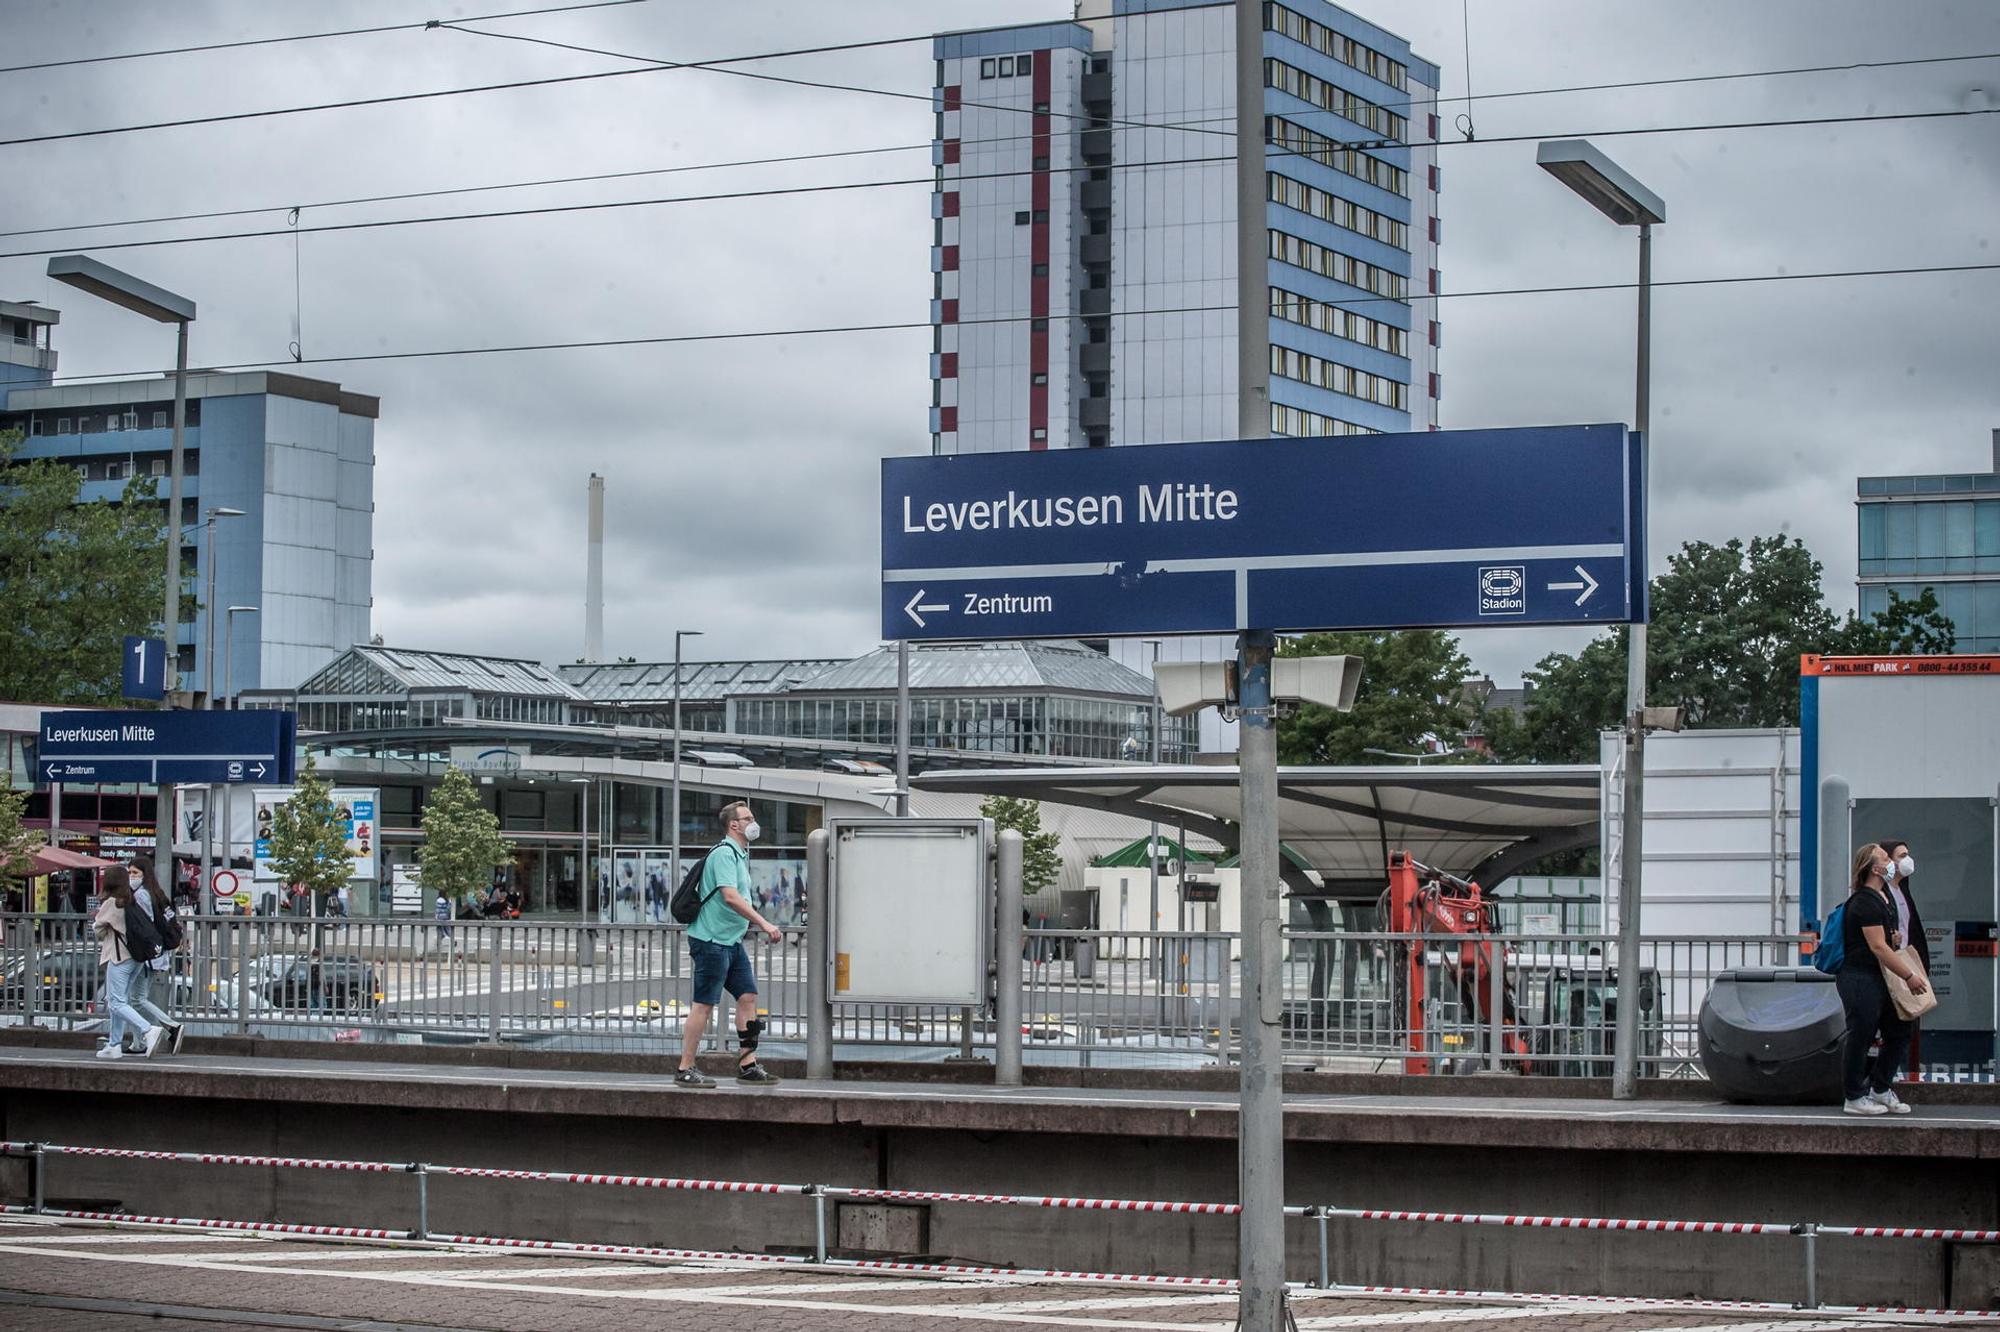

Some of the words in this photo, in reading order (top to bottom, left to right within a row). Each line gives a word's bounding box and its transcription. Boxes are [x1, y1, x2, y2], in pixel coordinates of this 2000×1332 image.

[902, 490, 1122, 534] Leverkusen
[1137, 482, 1240, 525] Mitte
[963, 592, 1053, 616] Zentrum
[1482, 598, 1522, 609] Stadion
[134, 640, 146, 685] 1
[1834, 664, 1852, 673] HKL
[1853, 662, 1899, 672] MIETPARK
[1917, 663, 1941, 673] 0800
[46, 726, 118, 742] Leverkusen
[122, 725, 155, 742] Mitte
[65, 765, 95, 775] Zentrum
